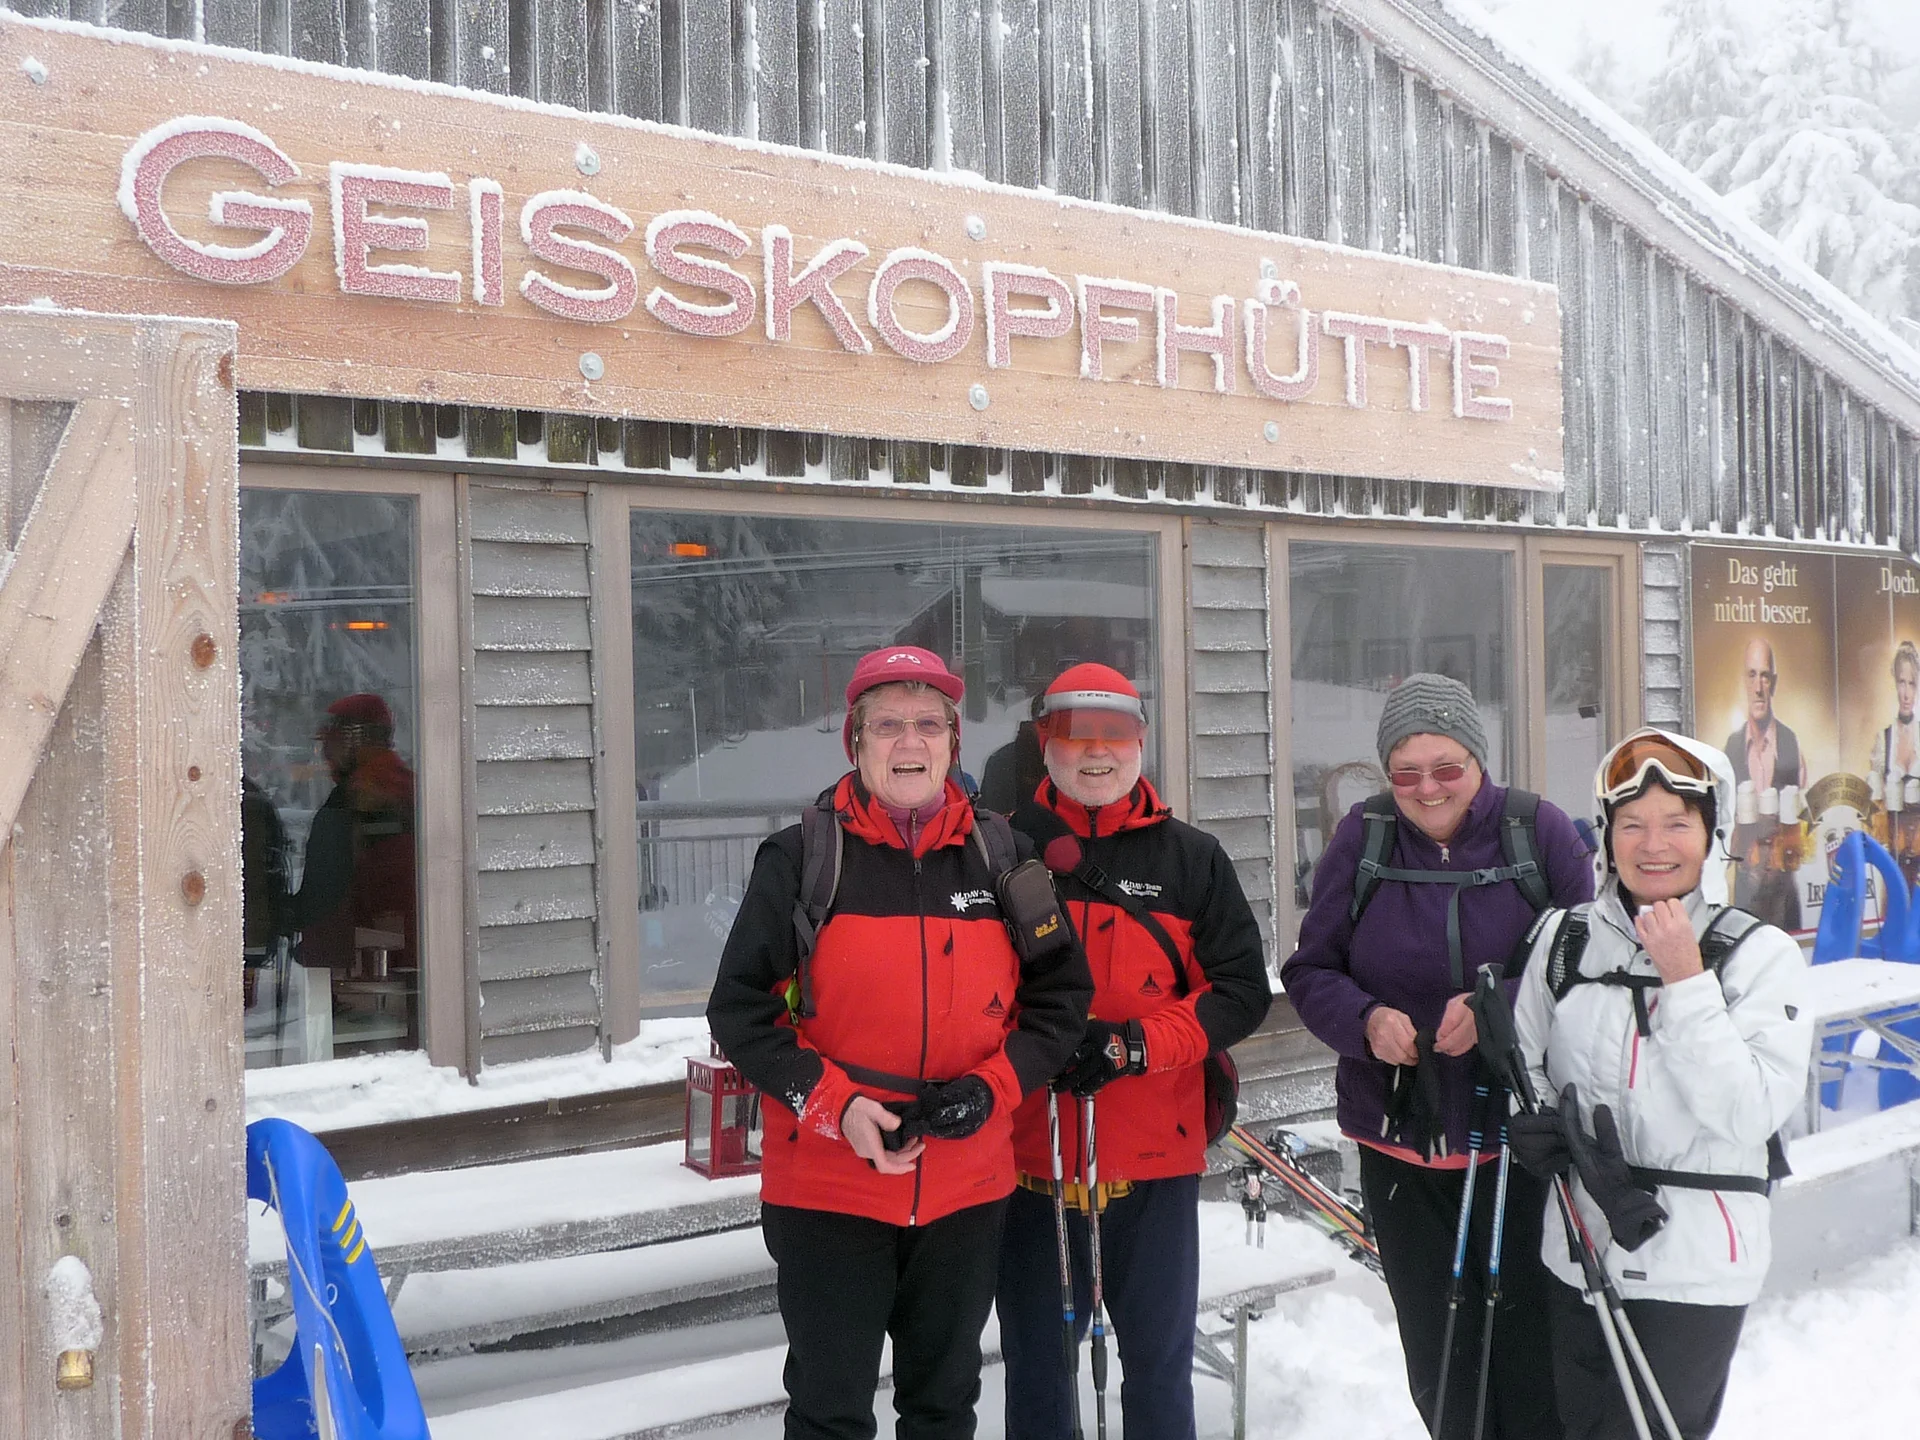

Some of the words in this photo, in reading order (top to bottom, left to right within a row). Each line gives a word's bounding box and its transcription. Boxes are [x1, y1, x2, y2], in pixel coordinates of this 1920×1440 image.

[116, 115, 1514, 420] GEISSKOPFHÜTTE
[1728, 558, 1758, 586] Das
[1763, 561, 1798, 593] geht
[1881, 567, 1920, 594] Doch.
[1714, 596, 1756, 623] nicht
[1760, 597, 1811, 624] besser.
